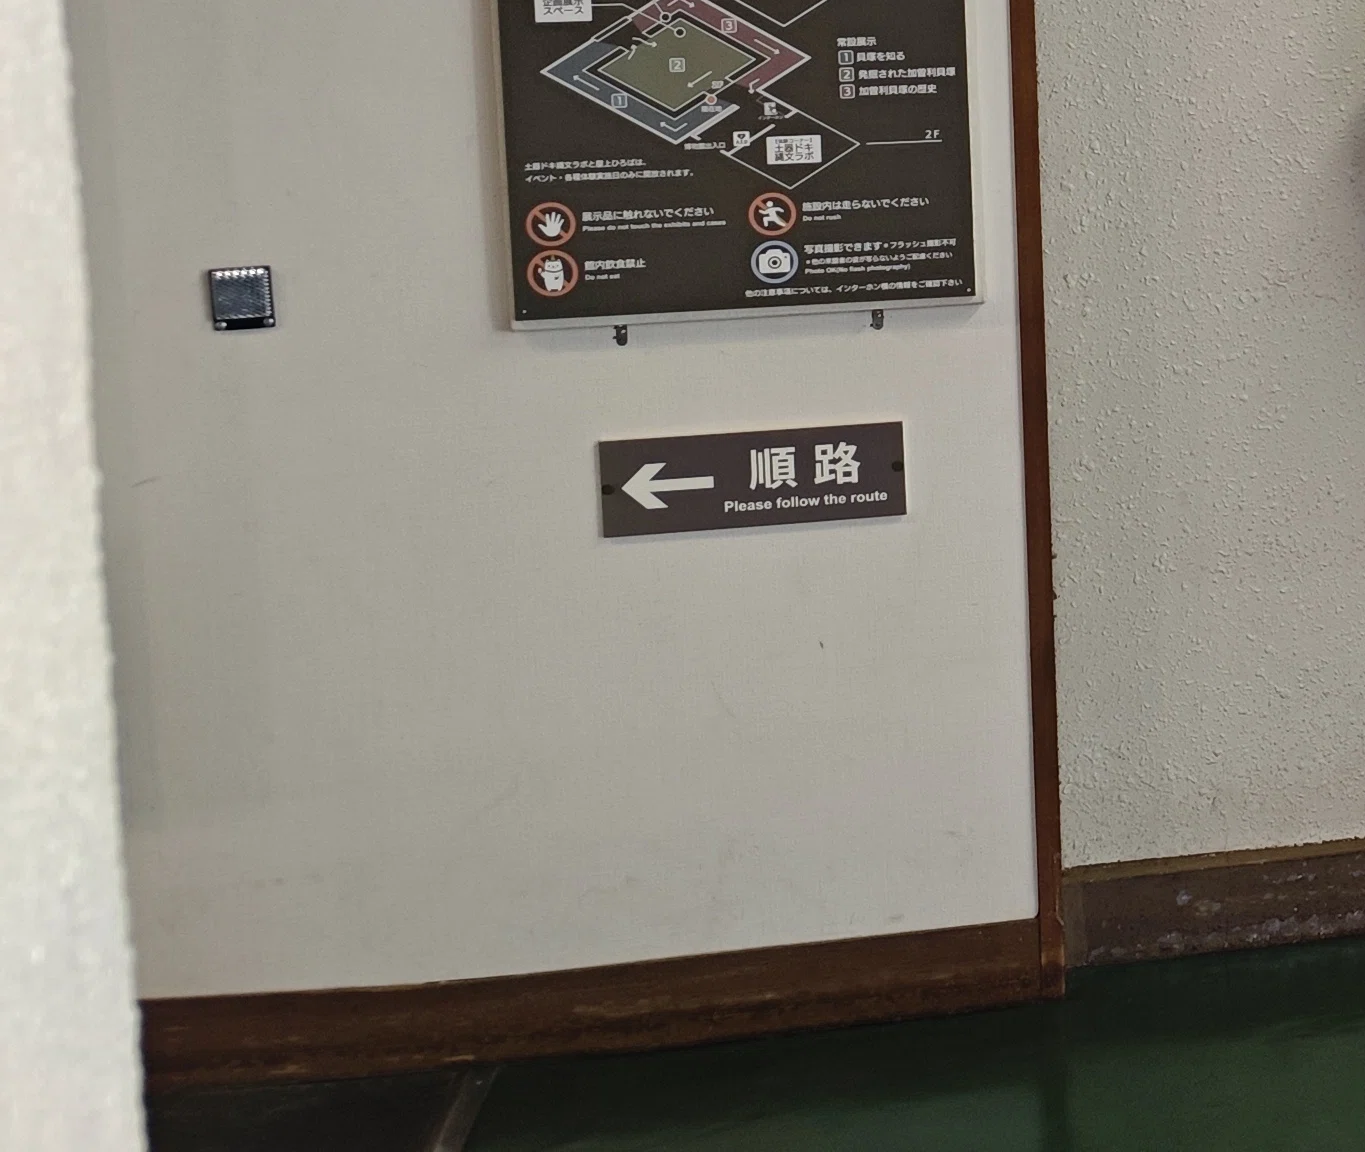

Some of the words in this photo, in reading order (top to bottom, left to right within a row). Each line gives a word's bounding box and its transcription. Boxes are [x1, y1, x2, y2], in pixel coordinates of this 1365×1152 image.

[542, 5, 584, 15] スペース
[843, 53, 849, 62] 1
[673, 61, 681, 70] 2
[843, 70, 850, 79] 2
[844, 87, 851, 96] 3
[924, 128, 940, 139] 2F
[749, 441, 860, 490] 順路
[723, 500, 772, 512] Please
[775, 495, 820, 508] follow
[823, 493, 846, 505] the
[850, 490, 887, 503] route
